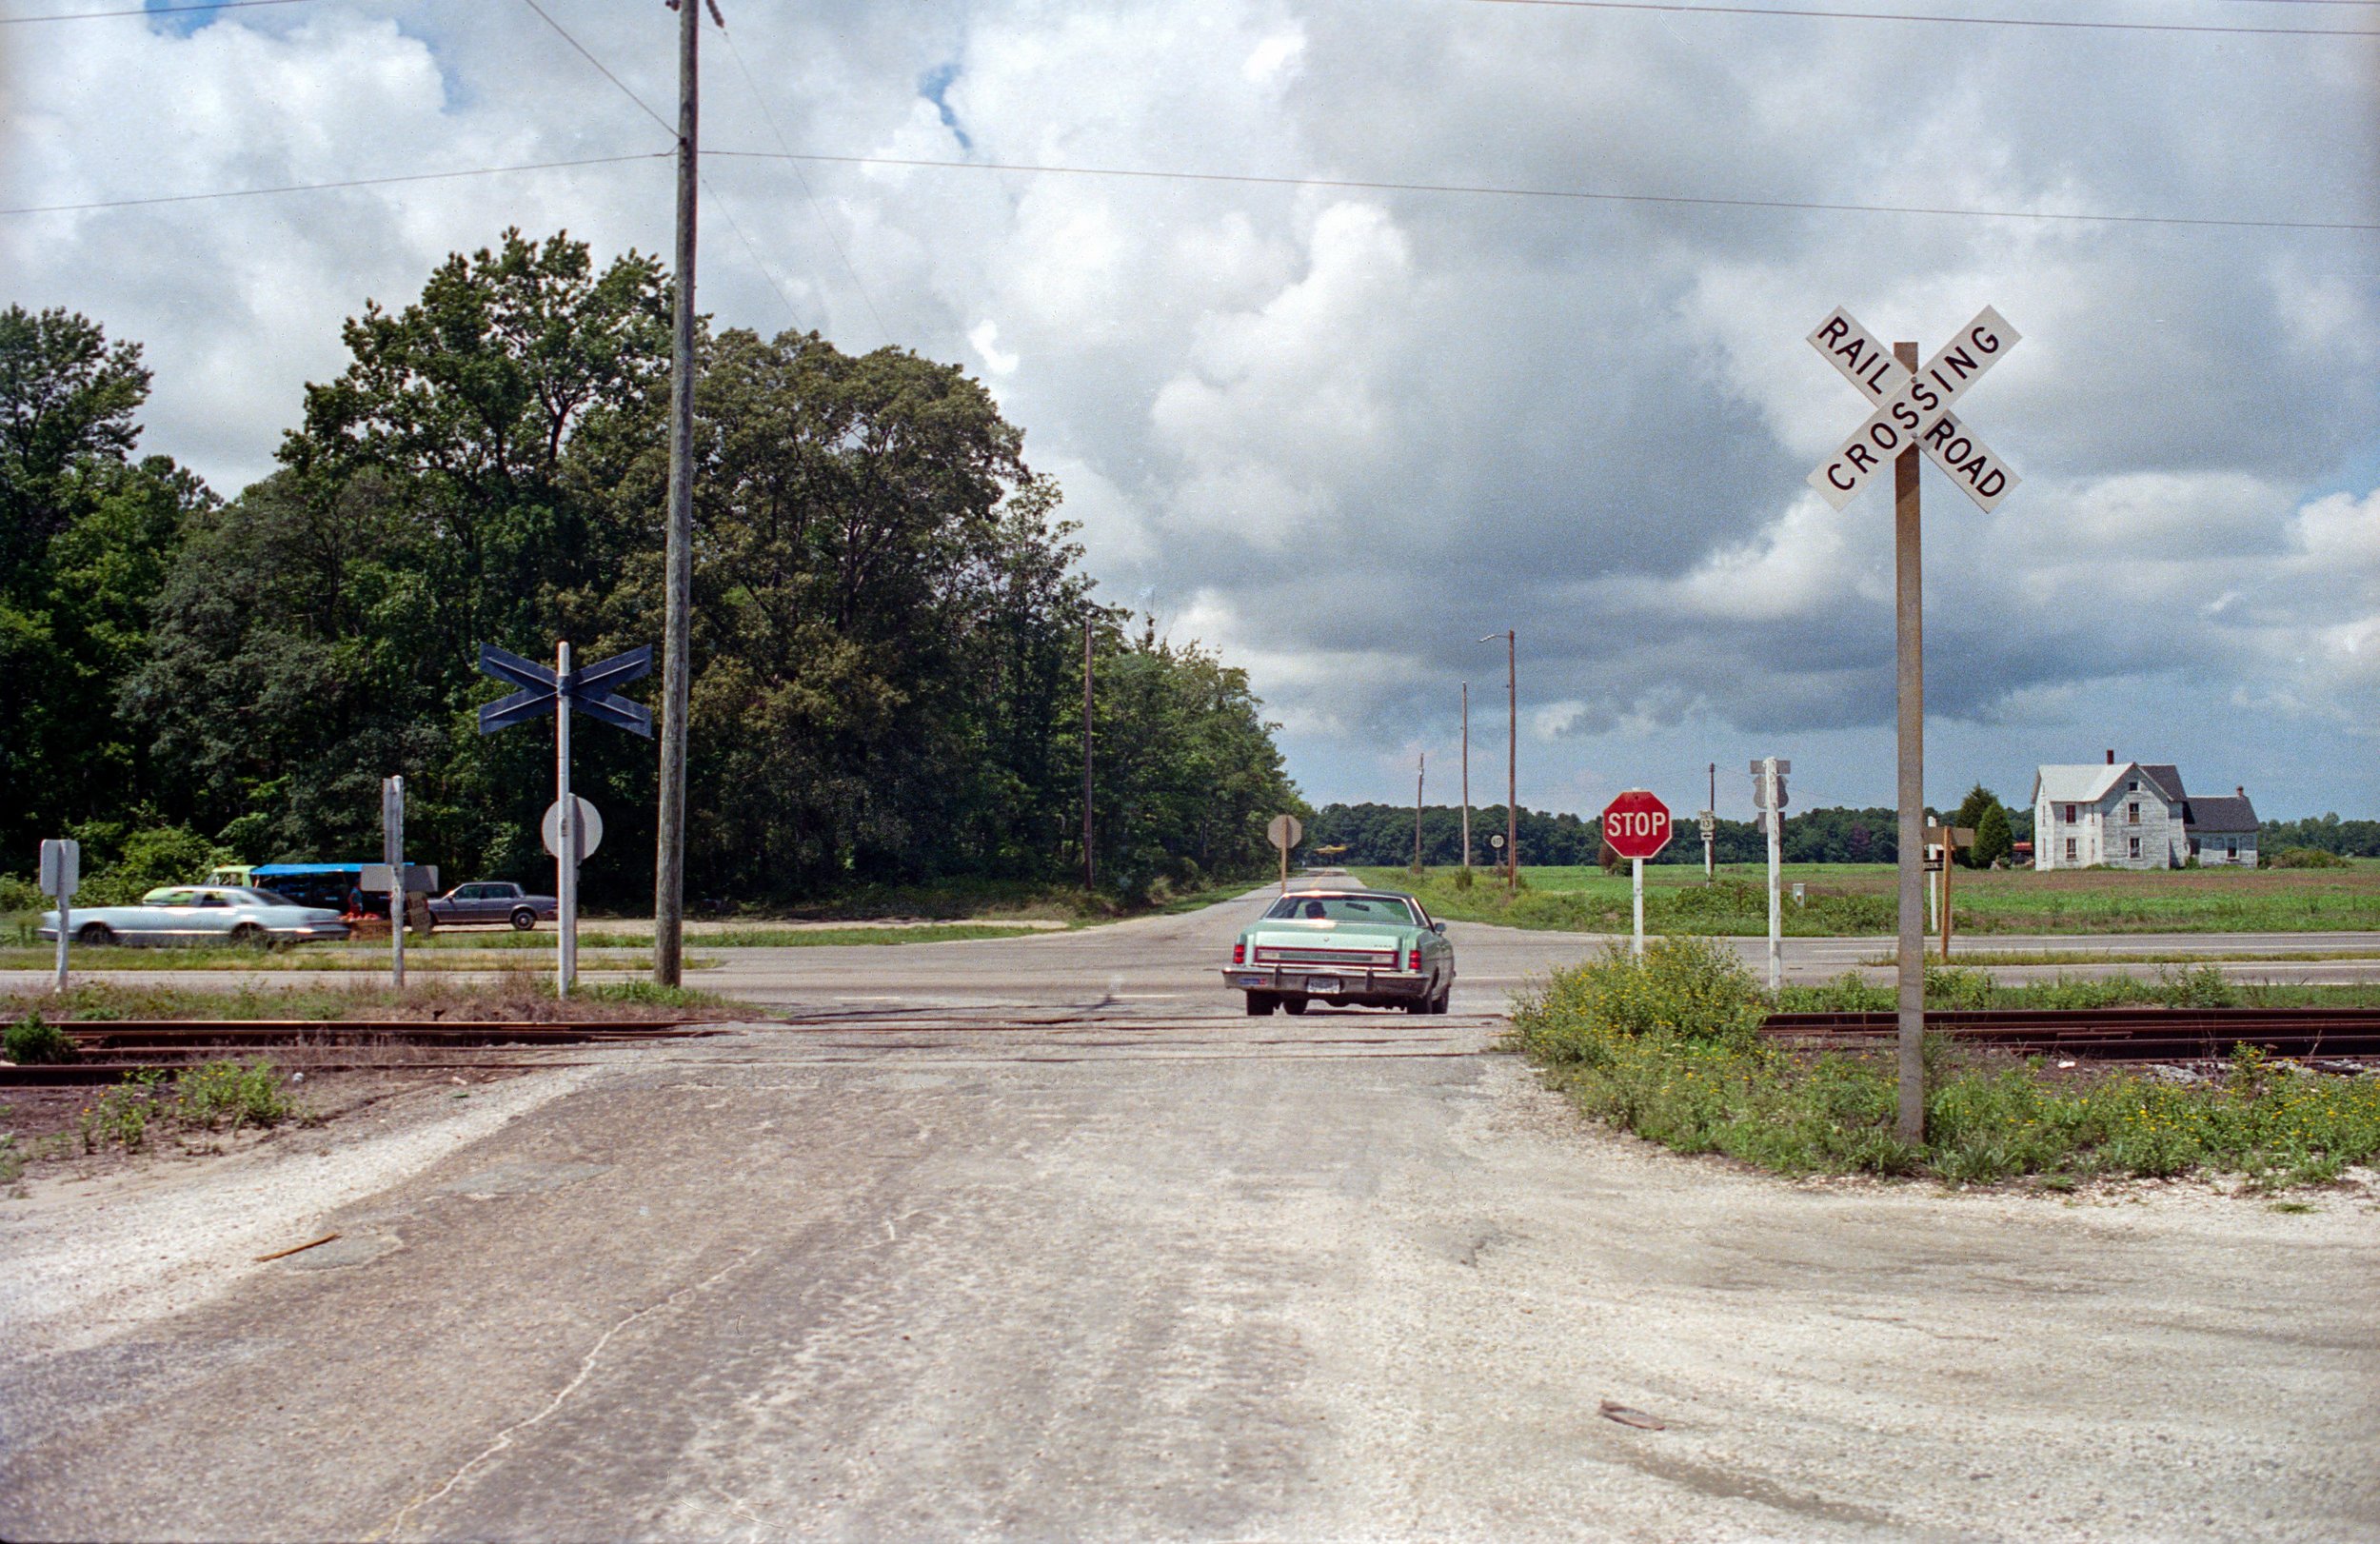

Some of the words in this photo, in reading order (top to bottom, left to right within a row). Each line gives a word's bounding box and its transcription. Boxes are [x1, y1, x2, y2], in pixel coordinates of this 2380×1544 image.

[1817, 316, 1891, 395] RAIL
[1924, 418, 2006, 498] ROAD
[1827, 327, 1999, 490] CROSSING
[1607, 811, 1666, 837] STOP
[1702, 820, 1711, 828] 13
